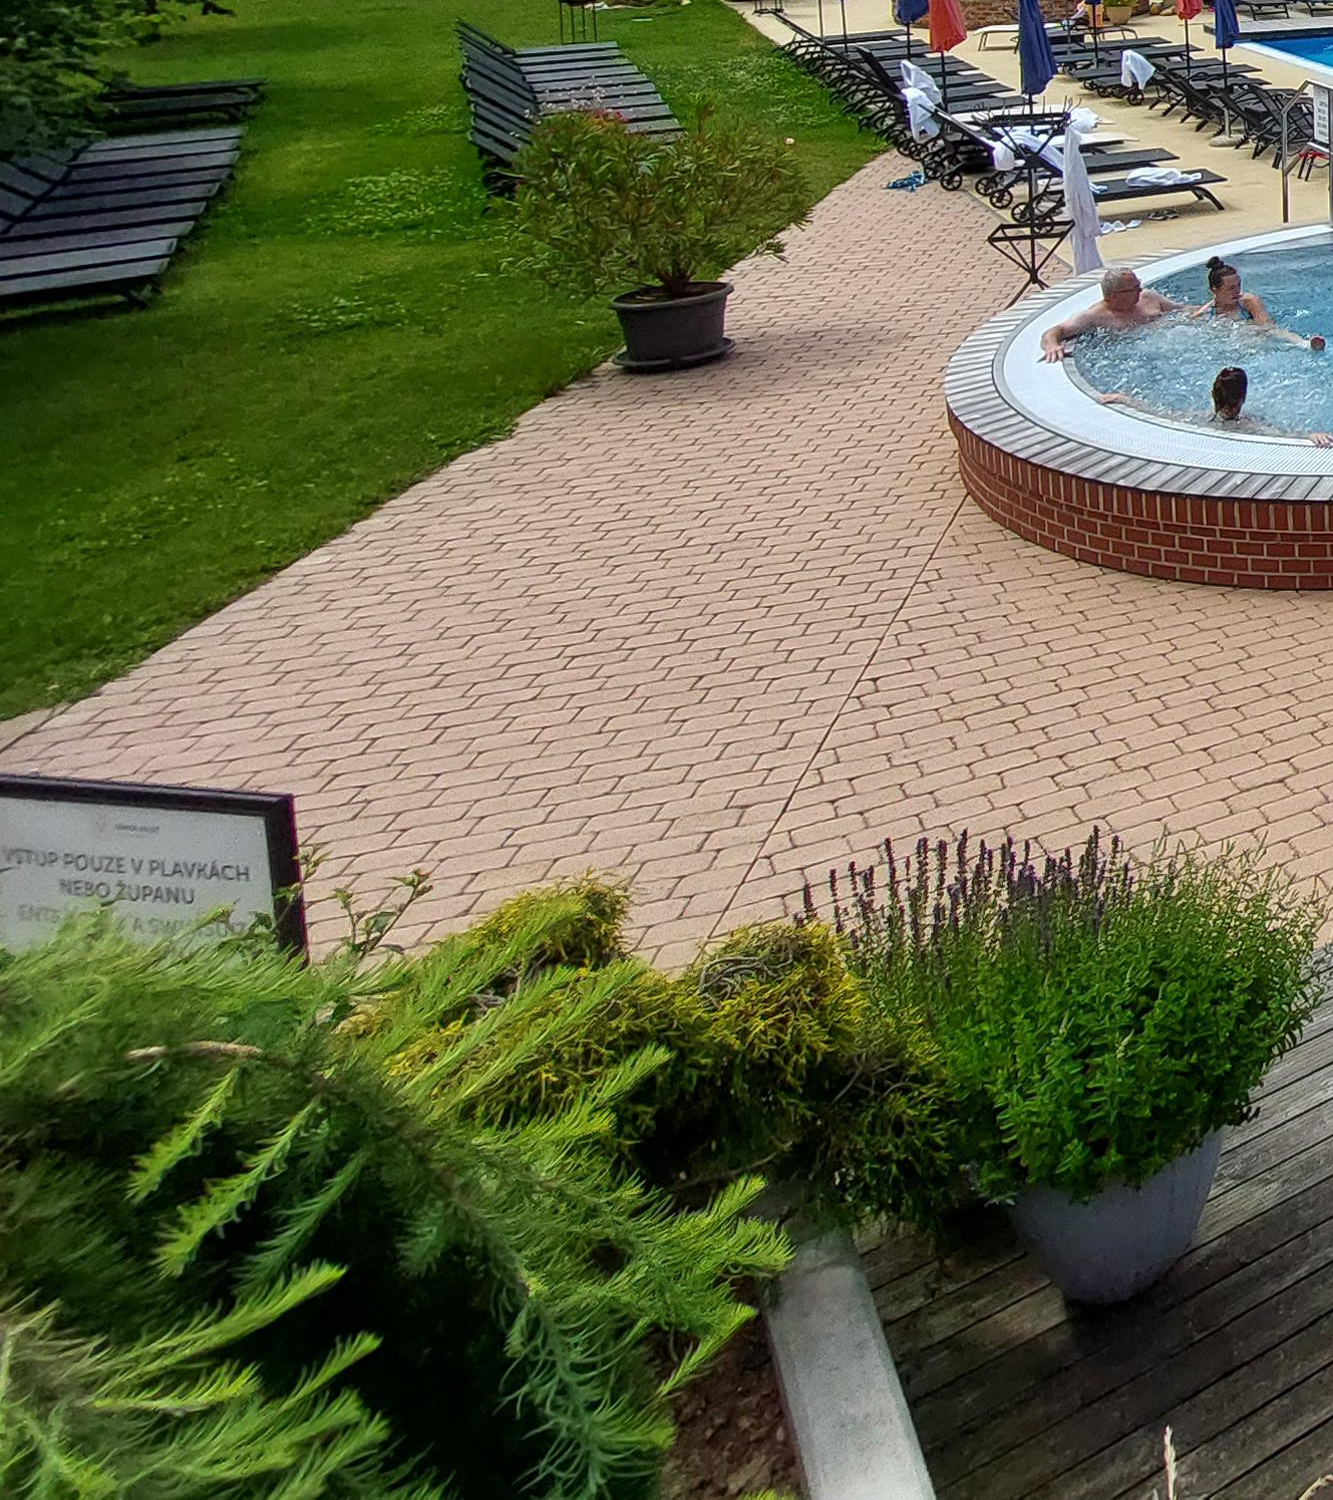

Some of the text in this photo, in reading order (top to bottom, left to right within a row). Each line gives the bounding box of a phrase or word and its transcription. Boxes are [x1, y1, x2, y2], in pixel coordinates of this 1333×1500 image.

[63, 852, 126, 874] POUZE
[130, 857, 144, 875] V
[148, 859, 250, 882] PLAVKÁCH
[60, 879, 195, 904] NEBO ŽUPANU
